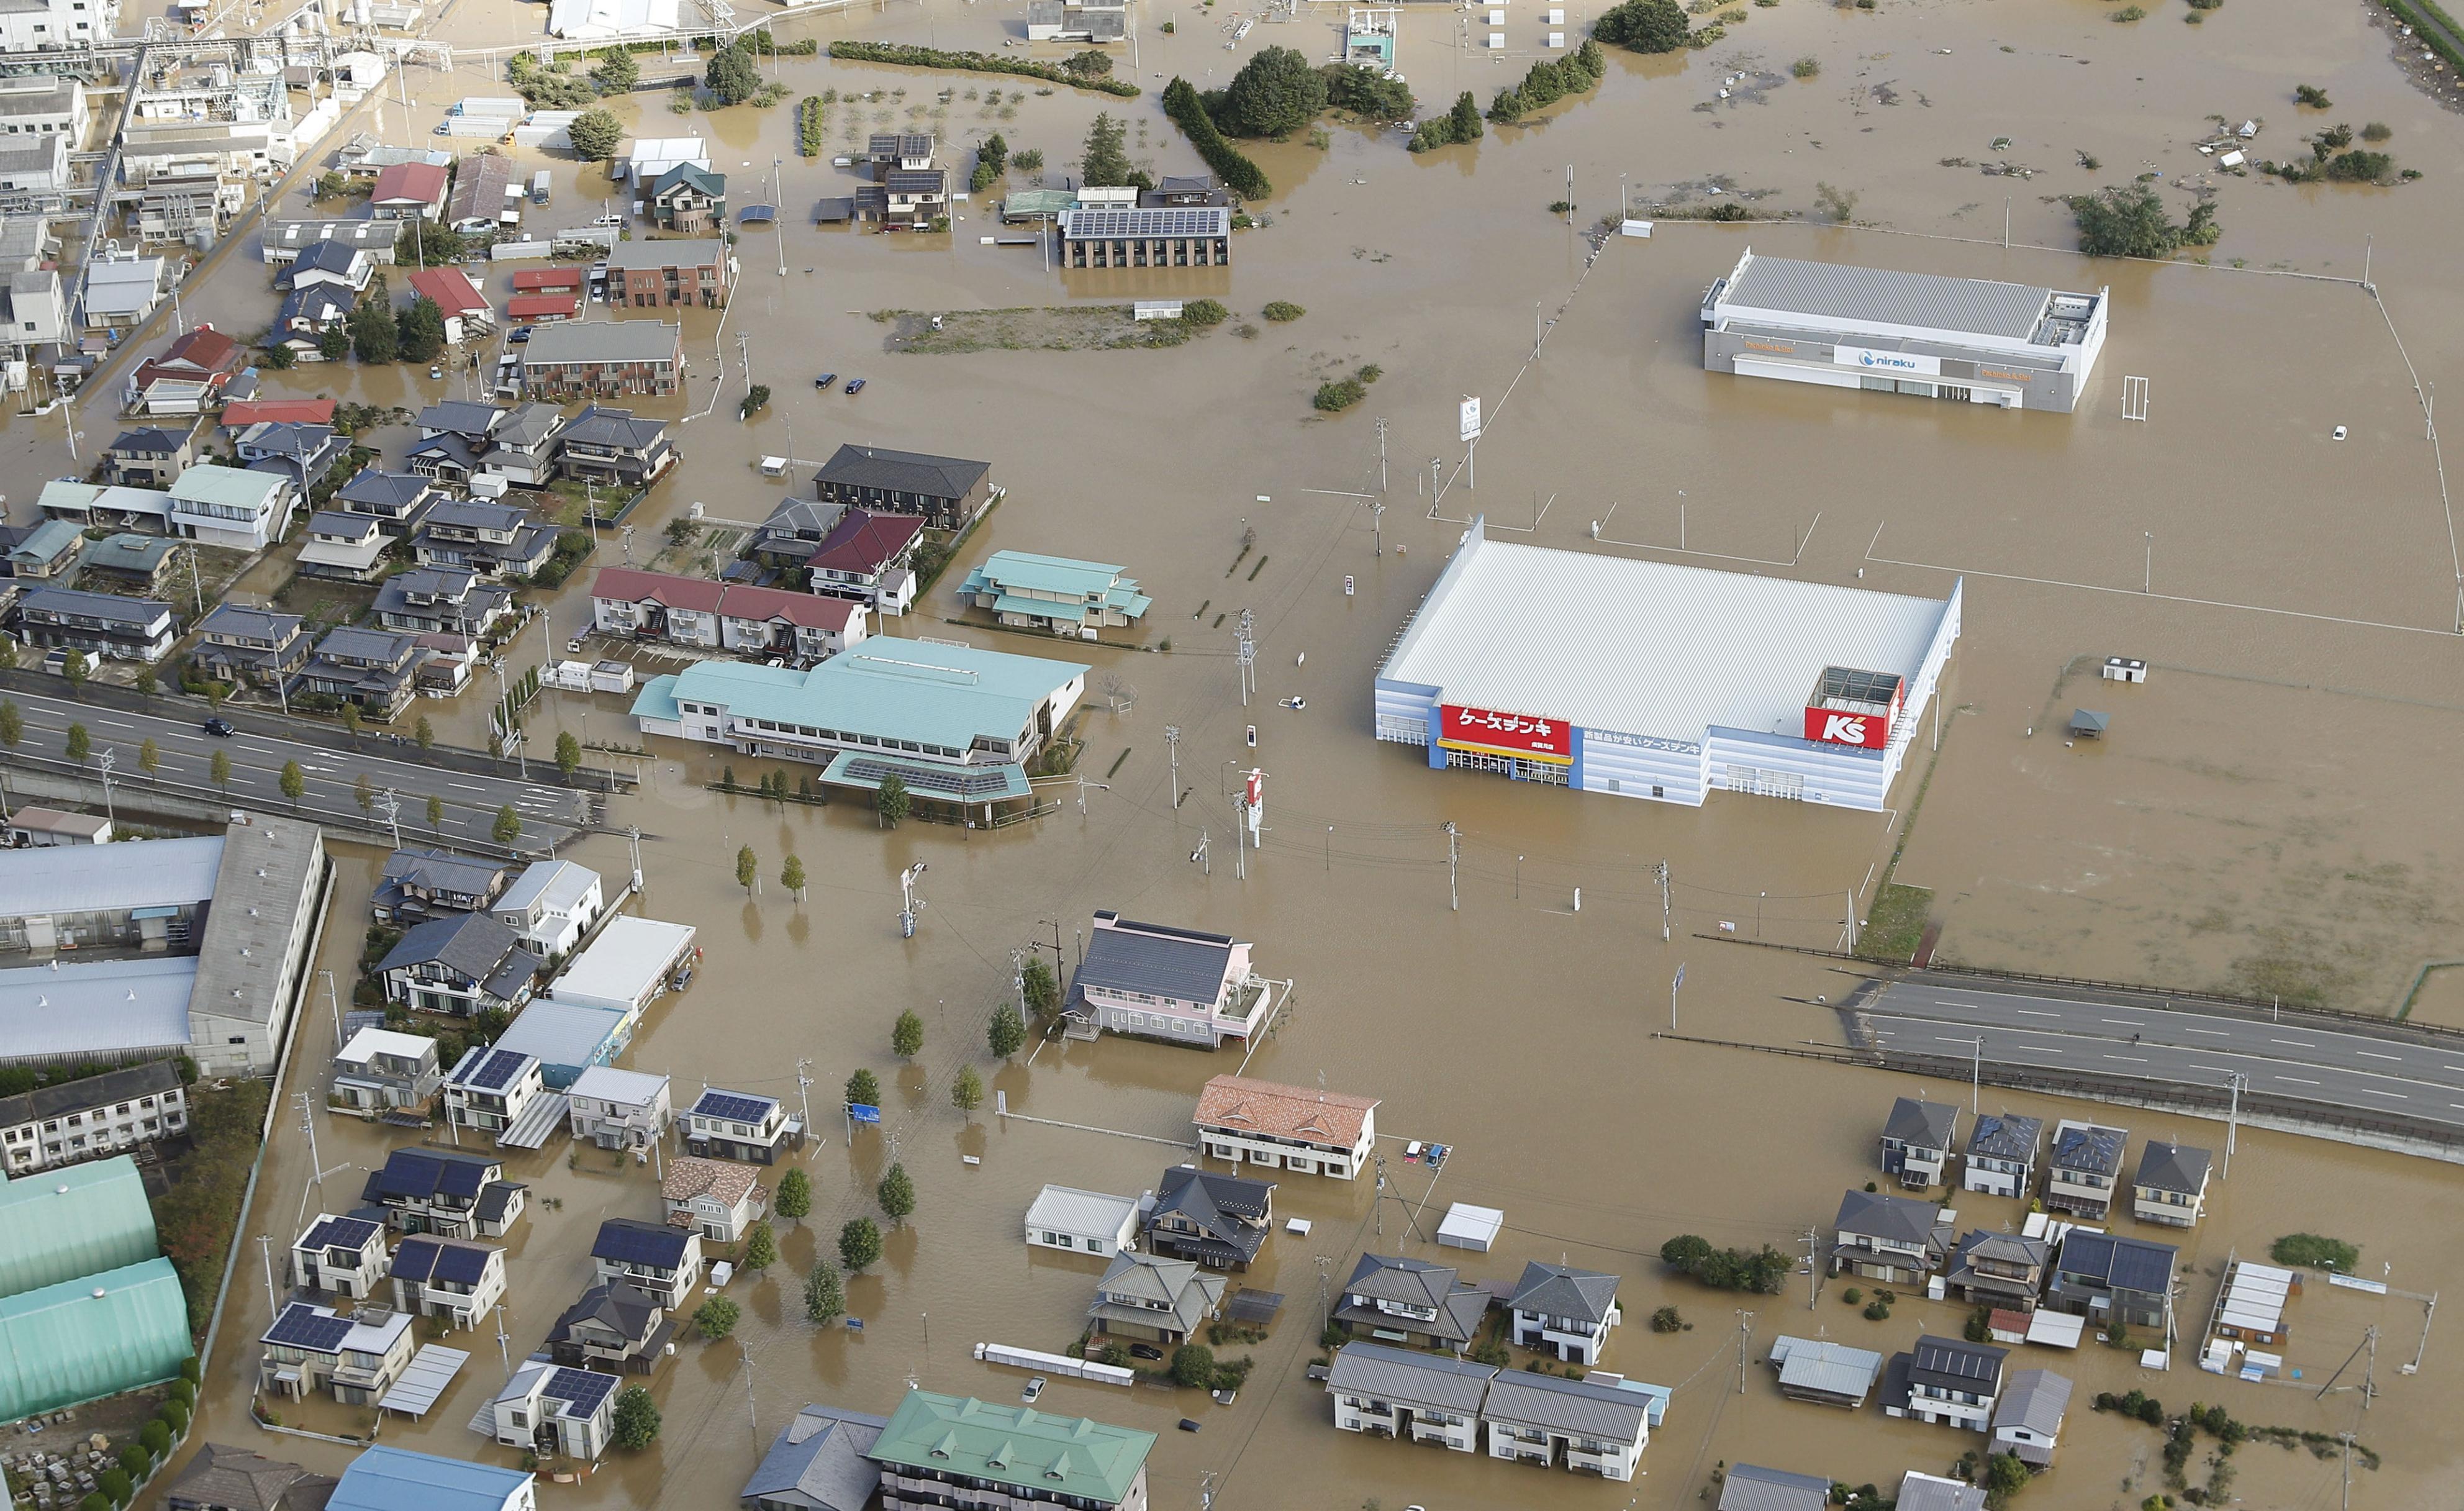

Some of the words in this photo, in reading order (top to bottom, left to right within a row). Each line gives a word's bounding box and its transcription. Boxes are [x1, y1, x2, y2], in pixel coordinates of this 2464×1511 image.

[1745, 341, 1773, 350] Pachinko
[1781, 345, 1794, 353] Slot
[1877, 356, 1915, 368] niraku
[1459, 712, 1551, 737] ケーズデンキ
[1584, 730, 1700, 755] 新製品が安いケーズデンキ
